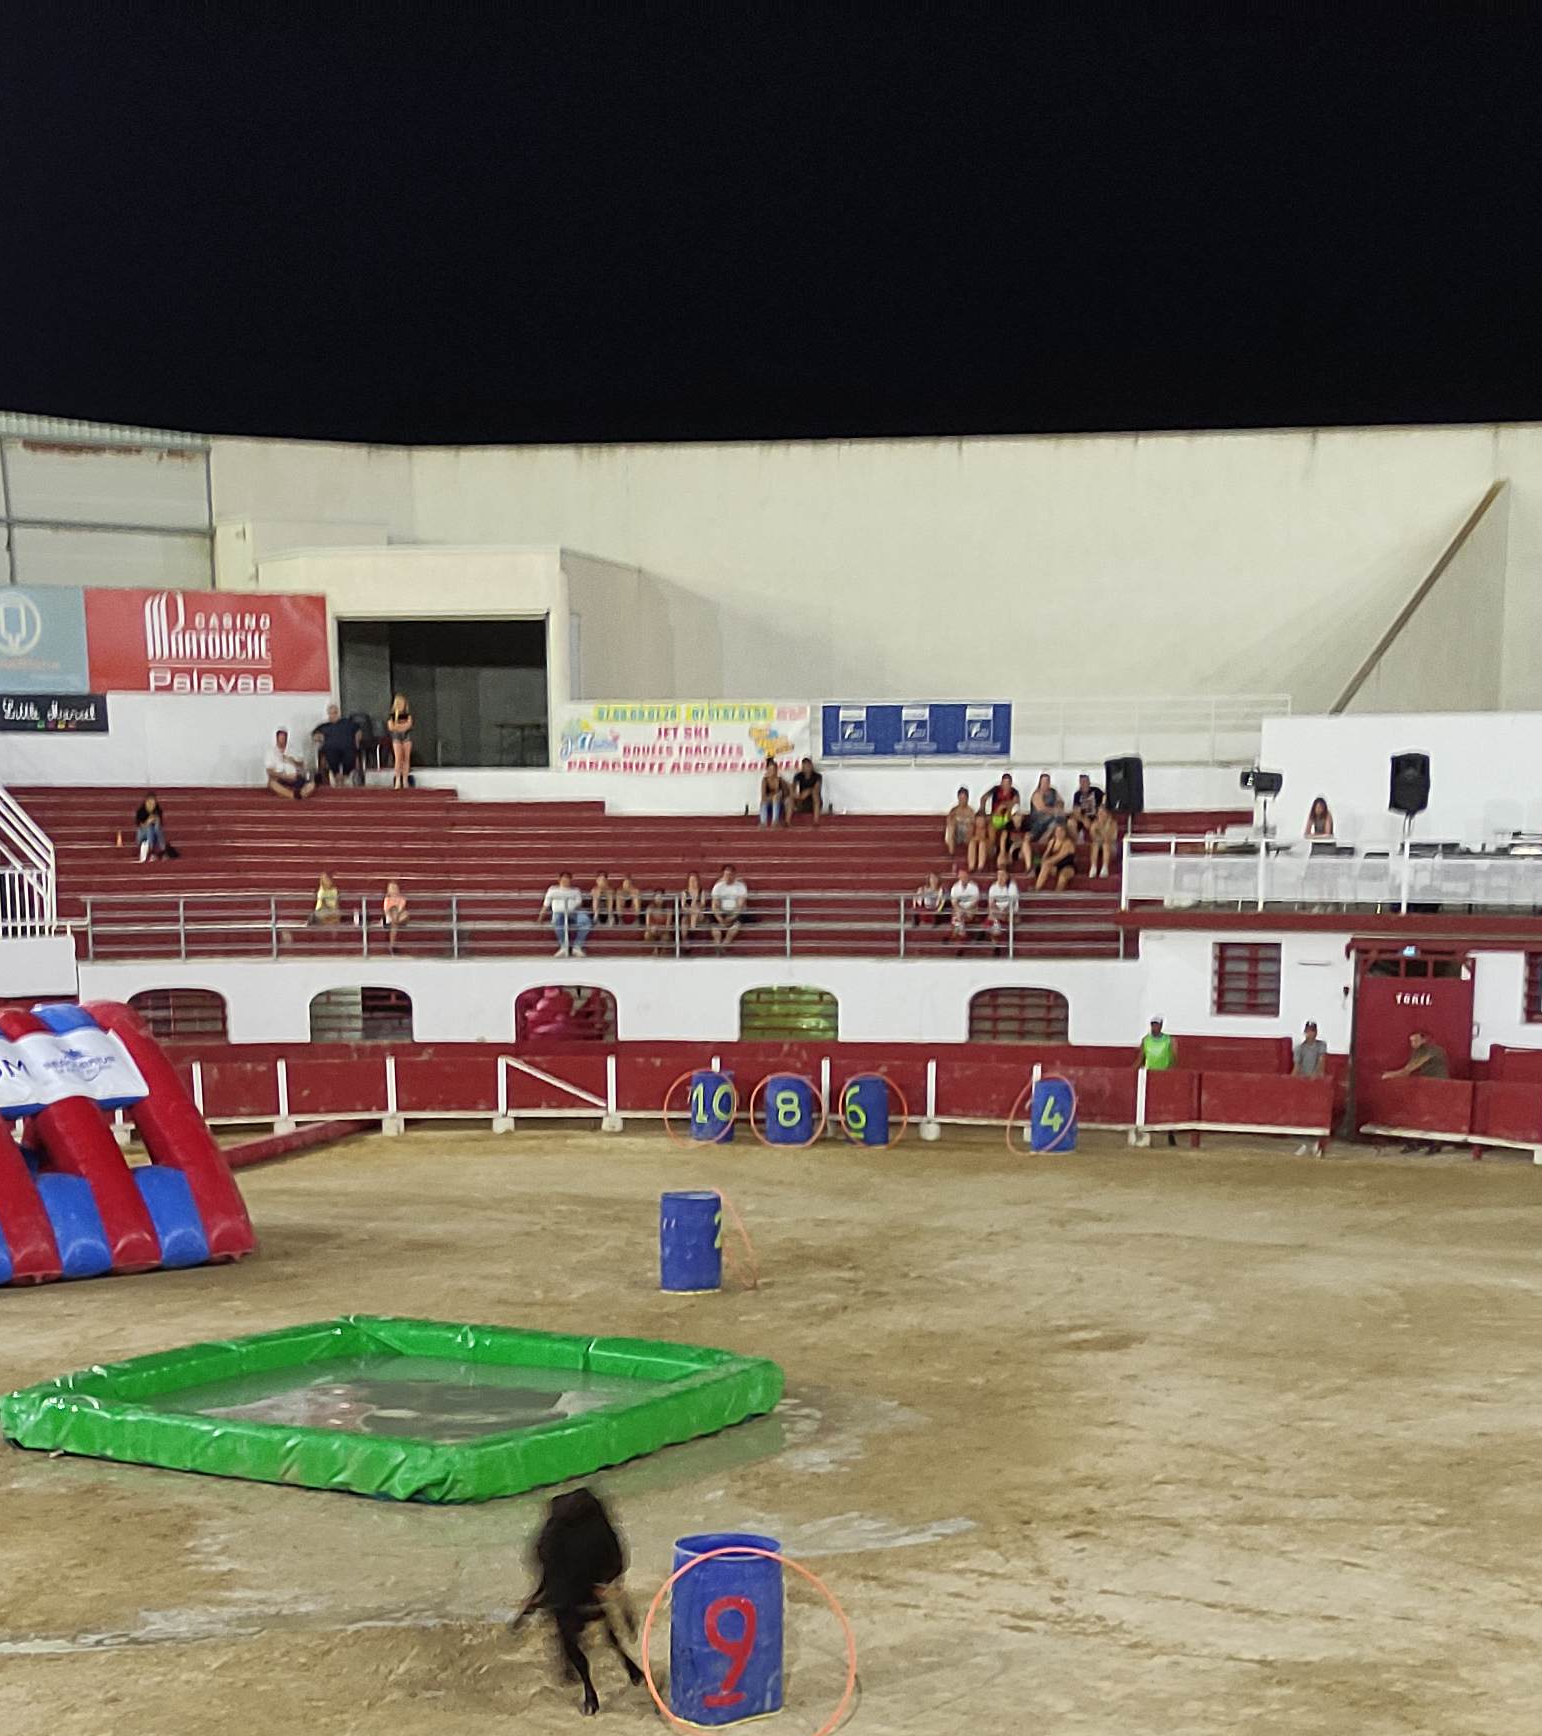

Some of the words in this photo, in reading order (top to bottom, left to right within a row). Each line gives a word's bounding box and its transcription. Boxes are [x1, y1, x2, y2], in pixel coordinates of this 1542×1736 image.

[195, 612, 270, 630] CASINO
[149, 667, 274, 694] Palavas
[657, 727, 678, 740] JET
[684, 727, 709, 740] SKI
[567, 761, 665, 774] PARACHUTE
[692, 1083, 734, 1124] 10
[776, 1090, 801, 1127] 8
[845, 1085, 866, 1129] 6
[1040, 1096, 1064, 1132] 4
[704, 1595, 757, 1693] 9
